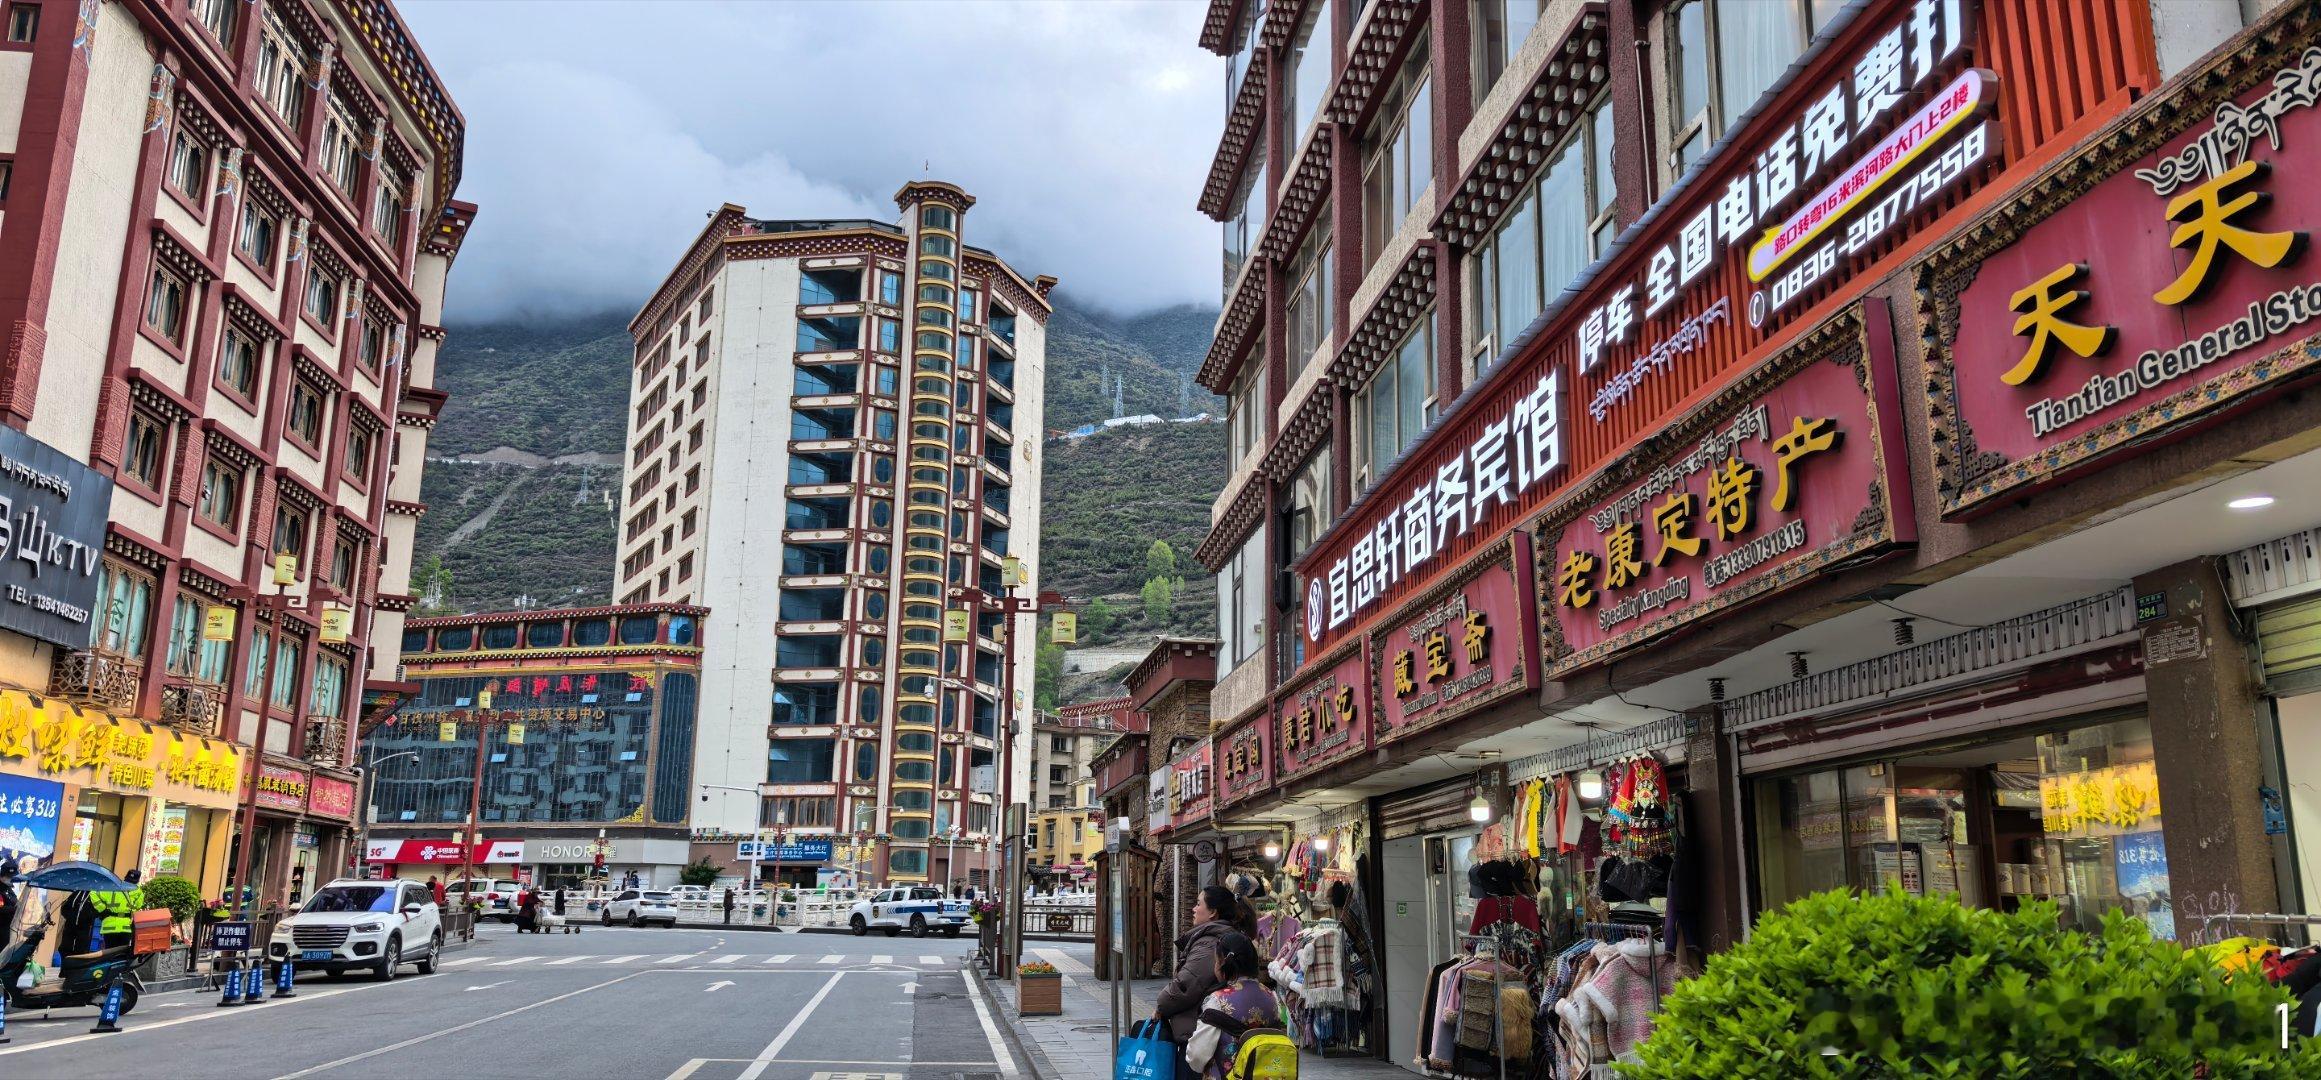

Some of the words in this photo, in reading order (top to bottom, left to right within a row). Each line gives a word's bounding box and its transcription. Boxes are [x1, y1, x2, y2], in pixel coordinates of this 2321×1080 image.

[1772, 124, 1986, 313] 0836-2877558
[2001, 160, 2294, 386] 天天
[1578, 284, 1632, 376] 停车
[2027, 365, 2138, 438] Tiantian
[2136, 302, 2262, 386] General
[1328, 368, 1560, 630] 宜思轩商务宾馆
[1559, 416, 1834, 608] 老康定特产
[46, 531, 98, 577] KTV
[1393, 609, 1486, 700] 藏宝斋
[2139, 606, 2156, 619] 284
[111, 762, 155, 790] 特色川菜
[541, 845, 592, 858] HONOR
